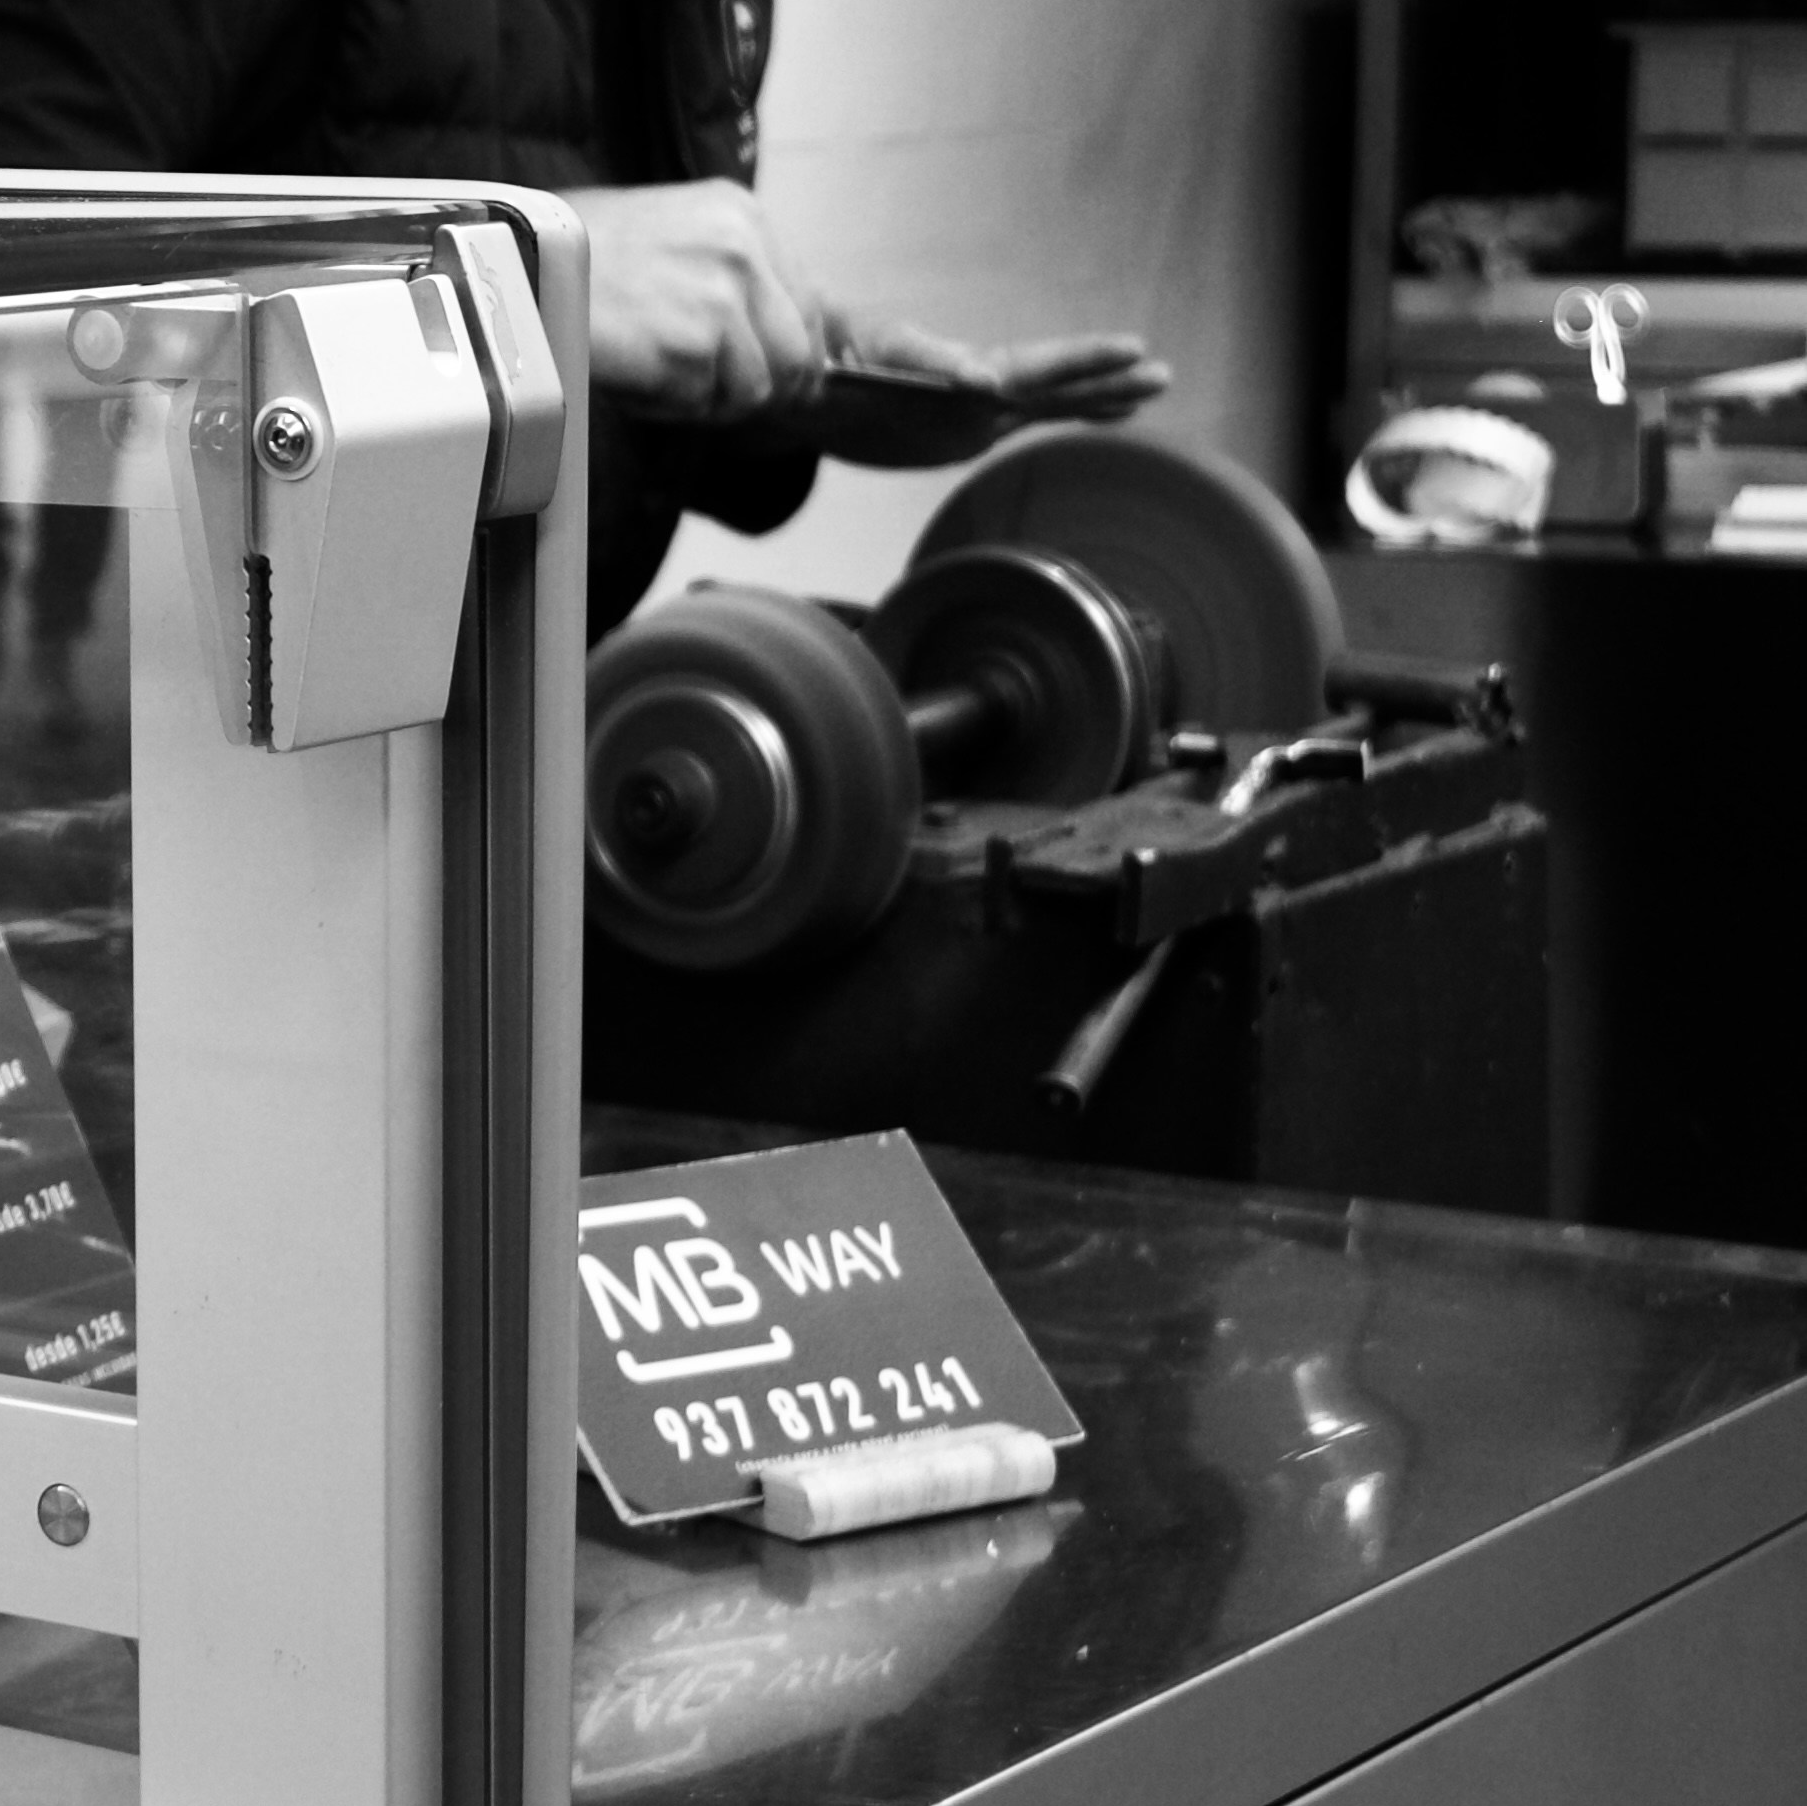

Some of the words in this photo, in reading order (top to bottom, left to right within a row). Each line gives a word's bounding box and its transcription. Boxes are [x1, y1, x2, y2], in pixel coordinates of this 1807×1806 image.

[24, 1180, 76, 1221] 3,70€
[578, 1235, 761, 1342] MB
[759, 1220, 902, 1297] WAY
[24, 1332, 77, 1372] desde
[76, 1310, 126, 1352] 1,25€
[652, 1395, 756, 1462] 937
[766, 1375, 877, 1442] 872
[878, 1355, 984, 1423] 241
